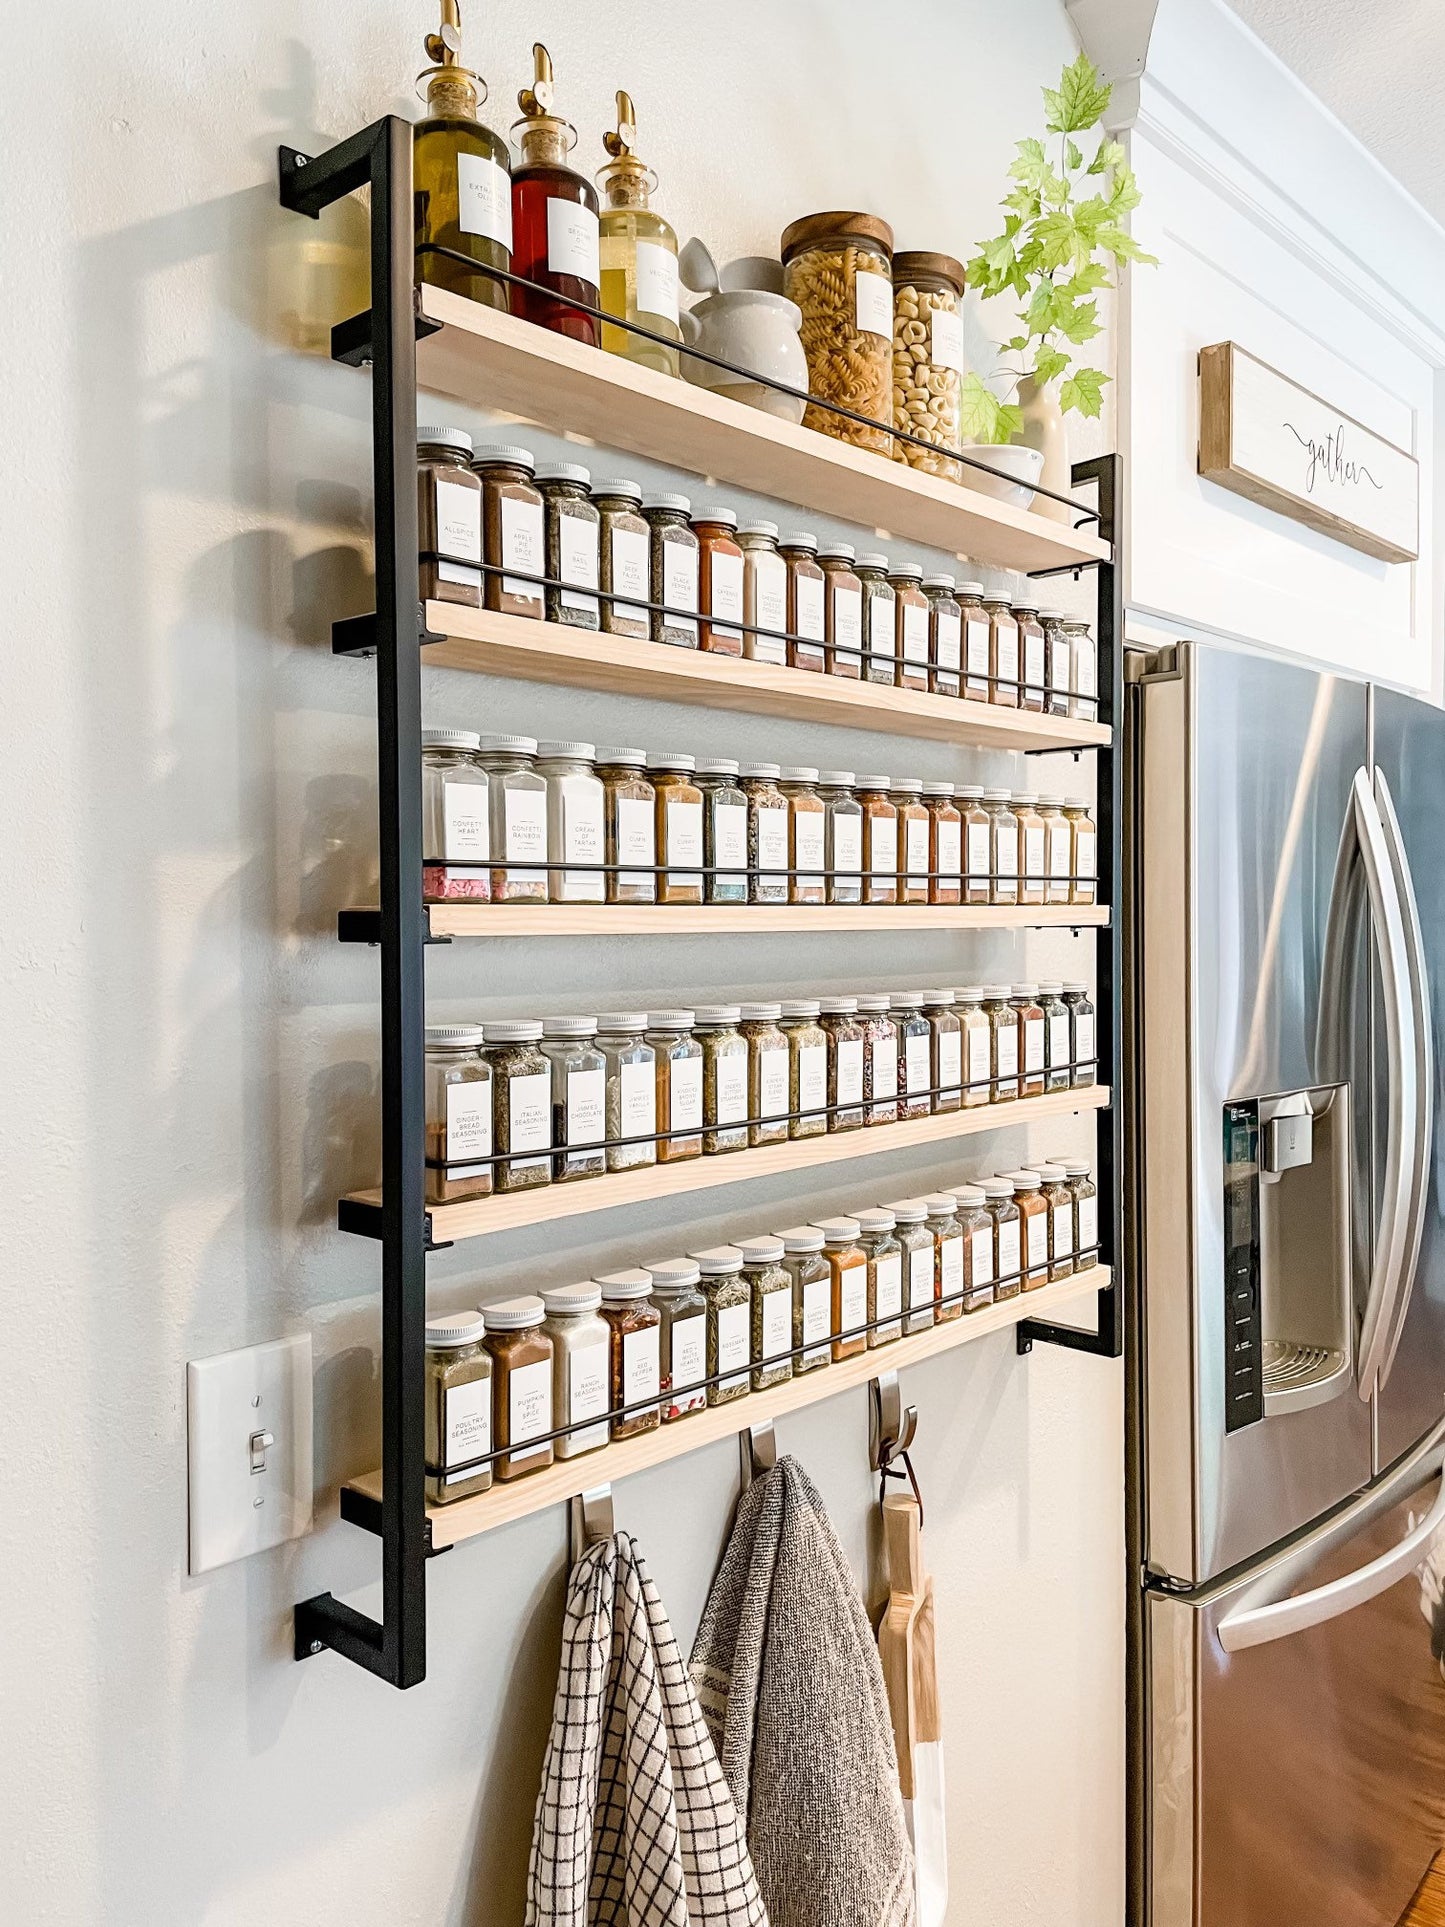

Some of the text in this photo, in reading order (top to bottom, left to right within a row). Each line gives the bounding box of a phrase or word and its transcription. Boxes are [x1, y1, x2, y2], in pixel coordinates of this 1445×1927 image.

[1283, 423, 1383, 492] gather
[444, 526, 475, 538] ALLSPICE
[513, 533, 533, 543] APPLE
[452, 820, 482, 829] CONFETTI
[511, 825, 543, 834] CONFETTI
[457, 827, 480, 835] HEART
[574, 826, 596, 834] CREAM
[512, 832, 542, 840] RAINBOW
[574, 839, 597, 847] TARTAR
[520, 1111, 543, 1119] ITALIAN
[570, 1110, 603, 1120] CHOCOLATE
[514, 1116, 549, 1126] SEASONING
[458, 1122, 481, 1131] BREAD
[451, 1128, 489, 1139] SEASONING
[636, 1361, 649, 1370] RED
[631, 1366, 654, 1378] PEPPER
[580, 1379, 601, 1390] RANCH
[573, 1383, 606, 1399] SEASONING
[517, 1394, 546, 1407] PUMPKIN
[526, 1402, 537, 1411] PIE
[522, 1409, 540, 1420] SPICE
[455, 1416, 485, 1430] POULTRY
[451, 1422, 489, 1439] SEASONING
